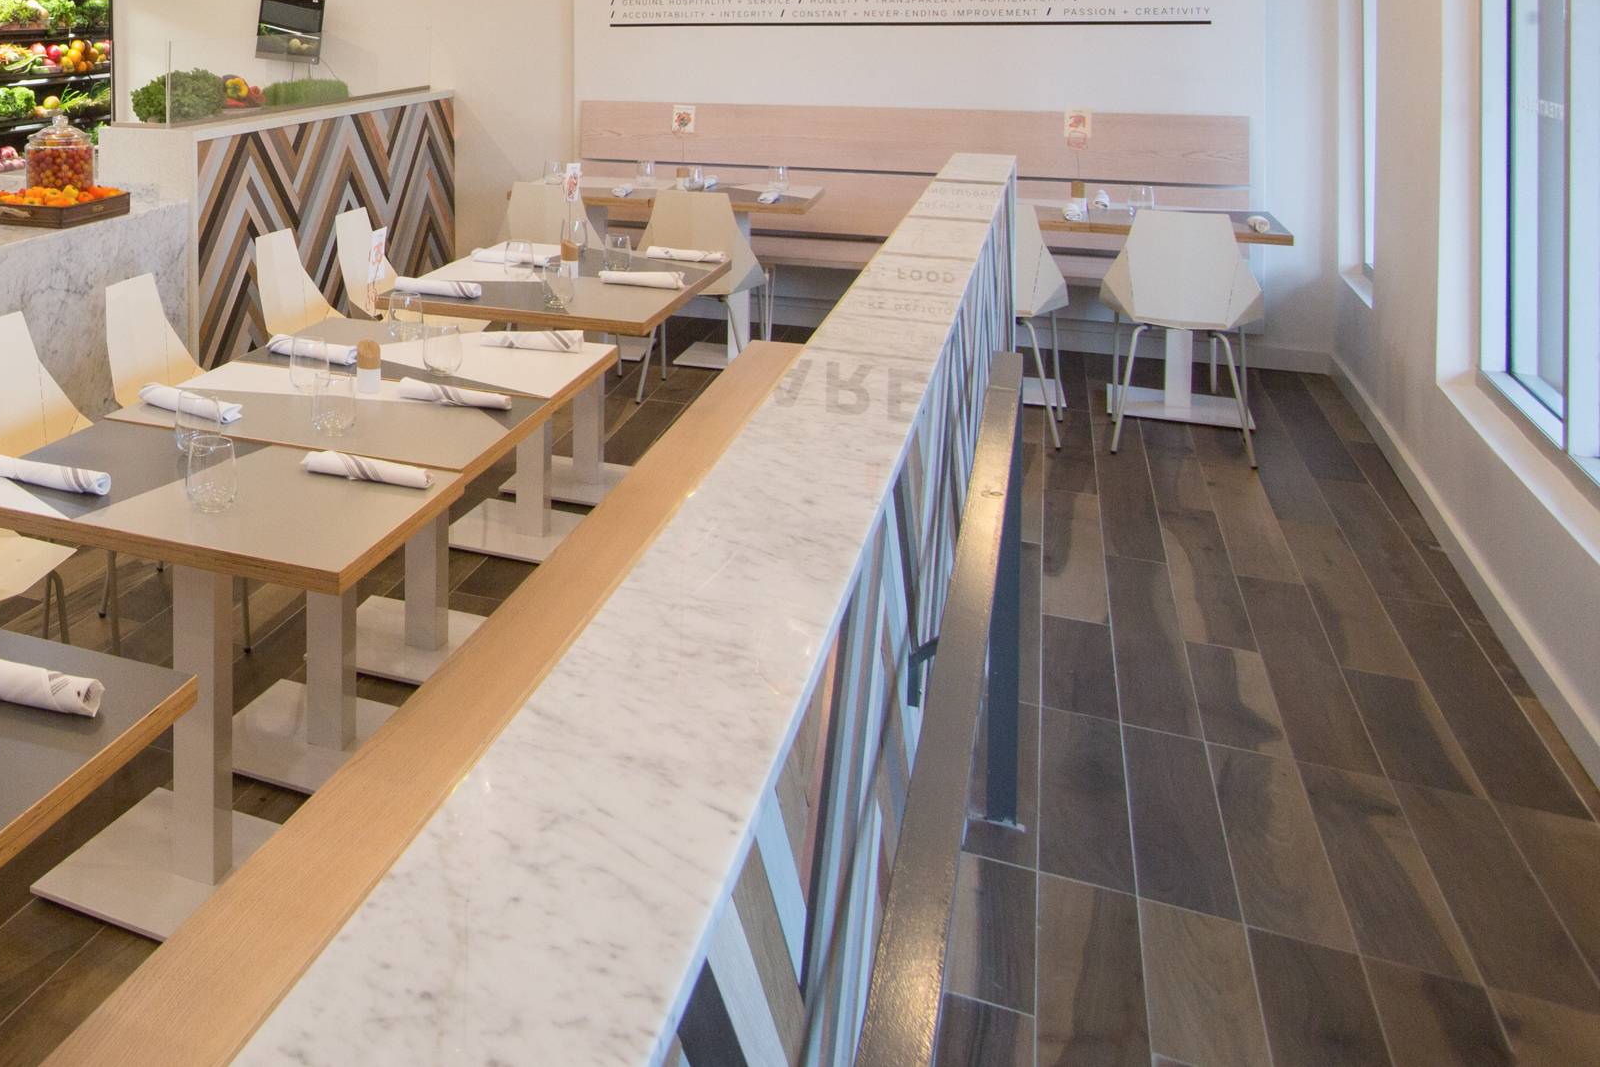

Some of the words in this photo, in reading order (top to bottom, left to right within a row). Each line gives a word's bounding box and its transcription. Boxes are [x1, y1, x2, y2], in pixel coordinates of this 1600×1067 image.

[622, 11, 705, 19] ACCOUNTABILITY
[719, 10, 774, 19] INTEGRITY
[791, 9, 848, 18] CONSTANT
[863, 9, 948, 18] NEVER-ENDING
[953, 8, 1038, 17] IMPROVEMENT
[1064, 8, 1116, 16] PASSION
[1135, 7, 1211, 16] CREATIVITY
